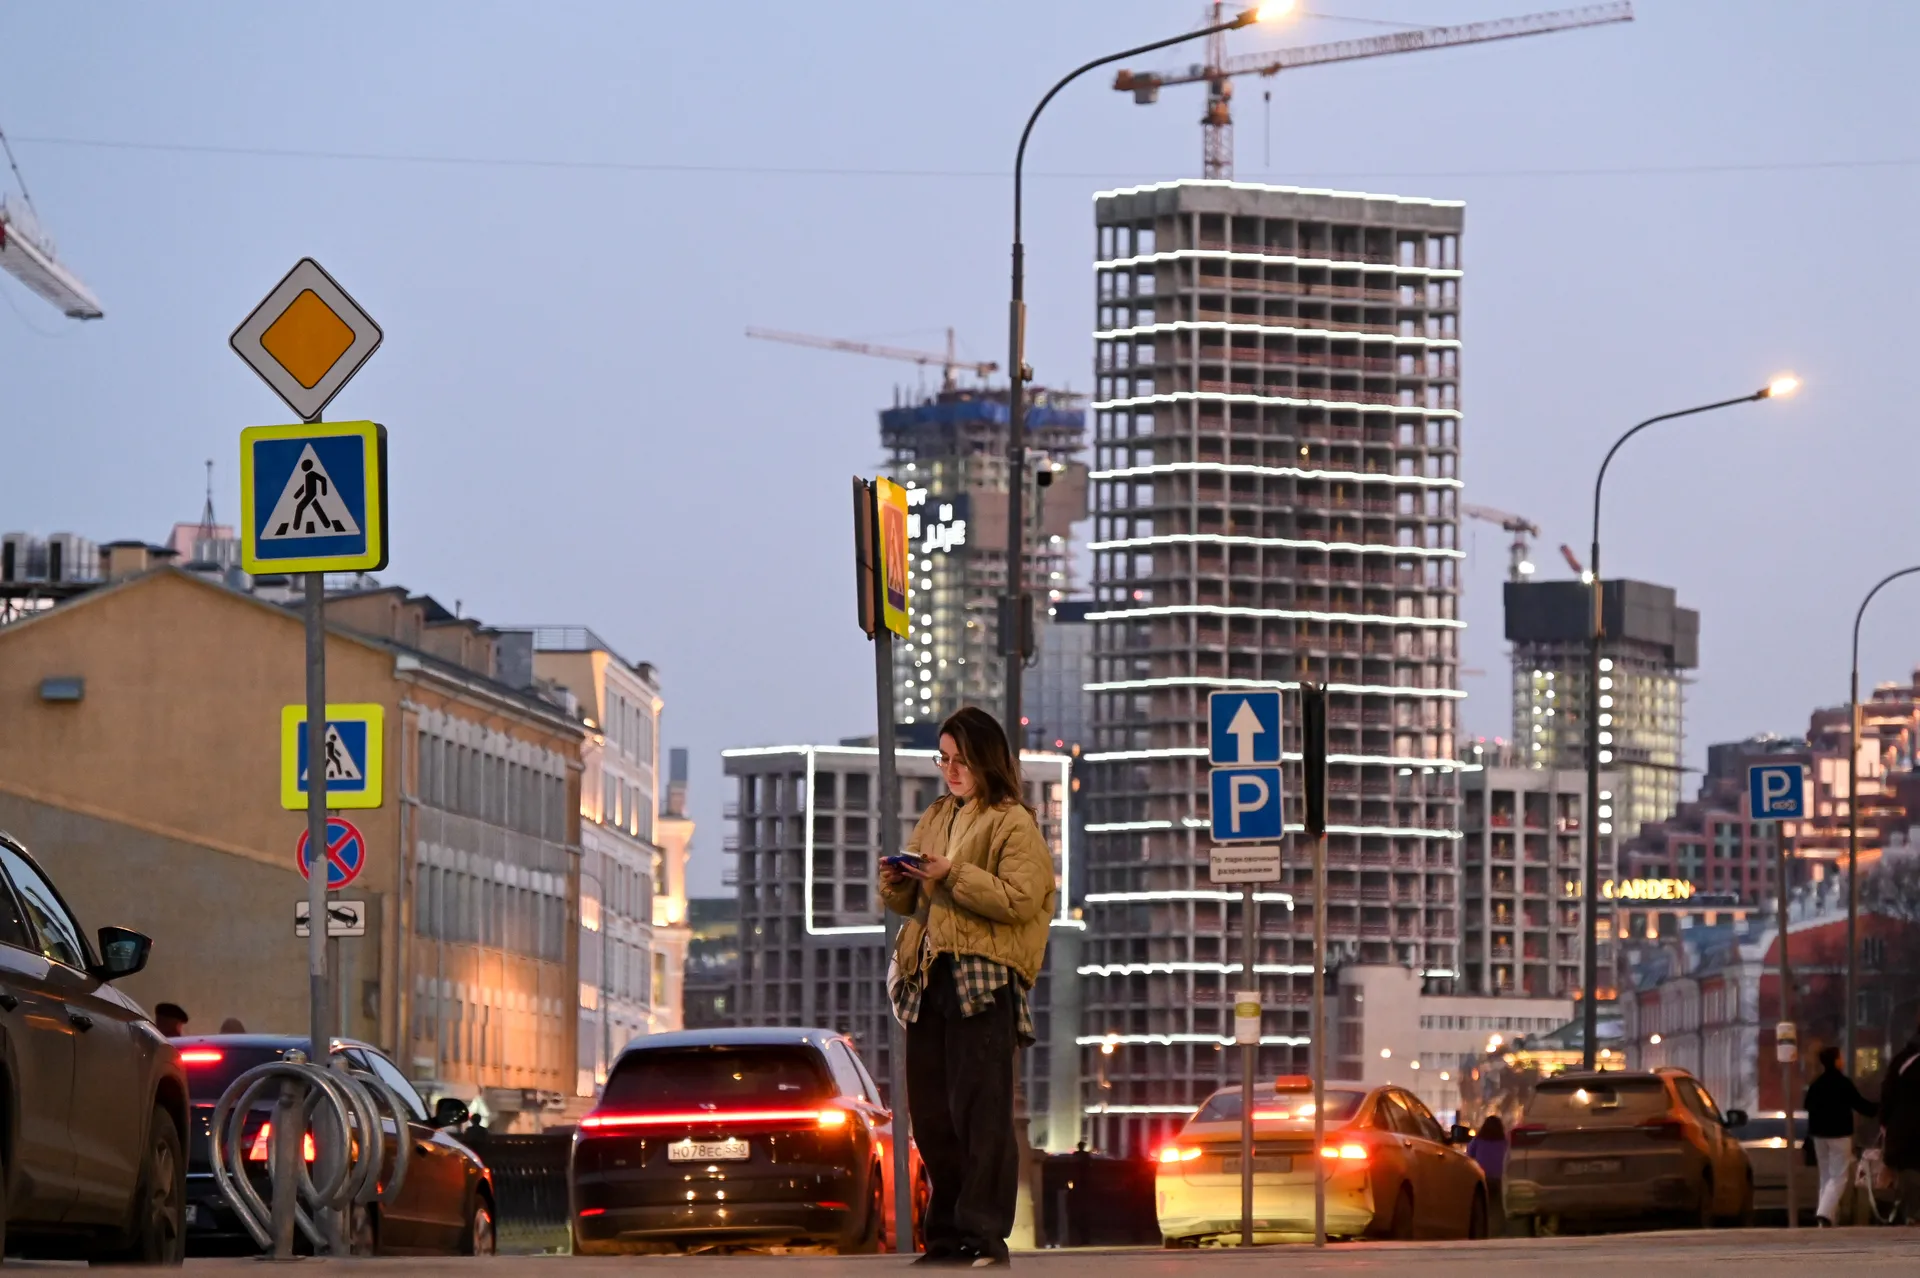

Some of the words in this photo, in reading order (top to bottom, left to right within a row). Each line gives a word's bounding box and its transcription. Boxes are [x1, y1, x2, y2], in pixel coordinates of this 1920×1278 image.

[1230, 775, 1269, 833] P
[1762, 770, 1791, 812] P
[1602, 878, 1690, 900] GARDEN
